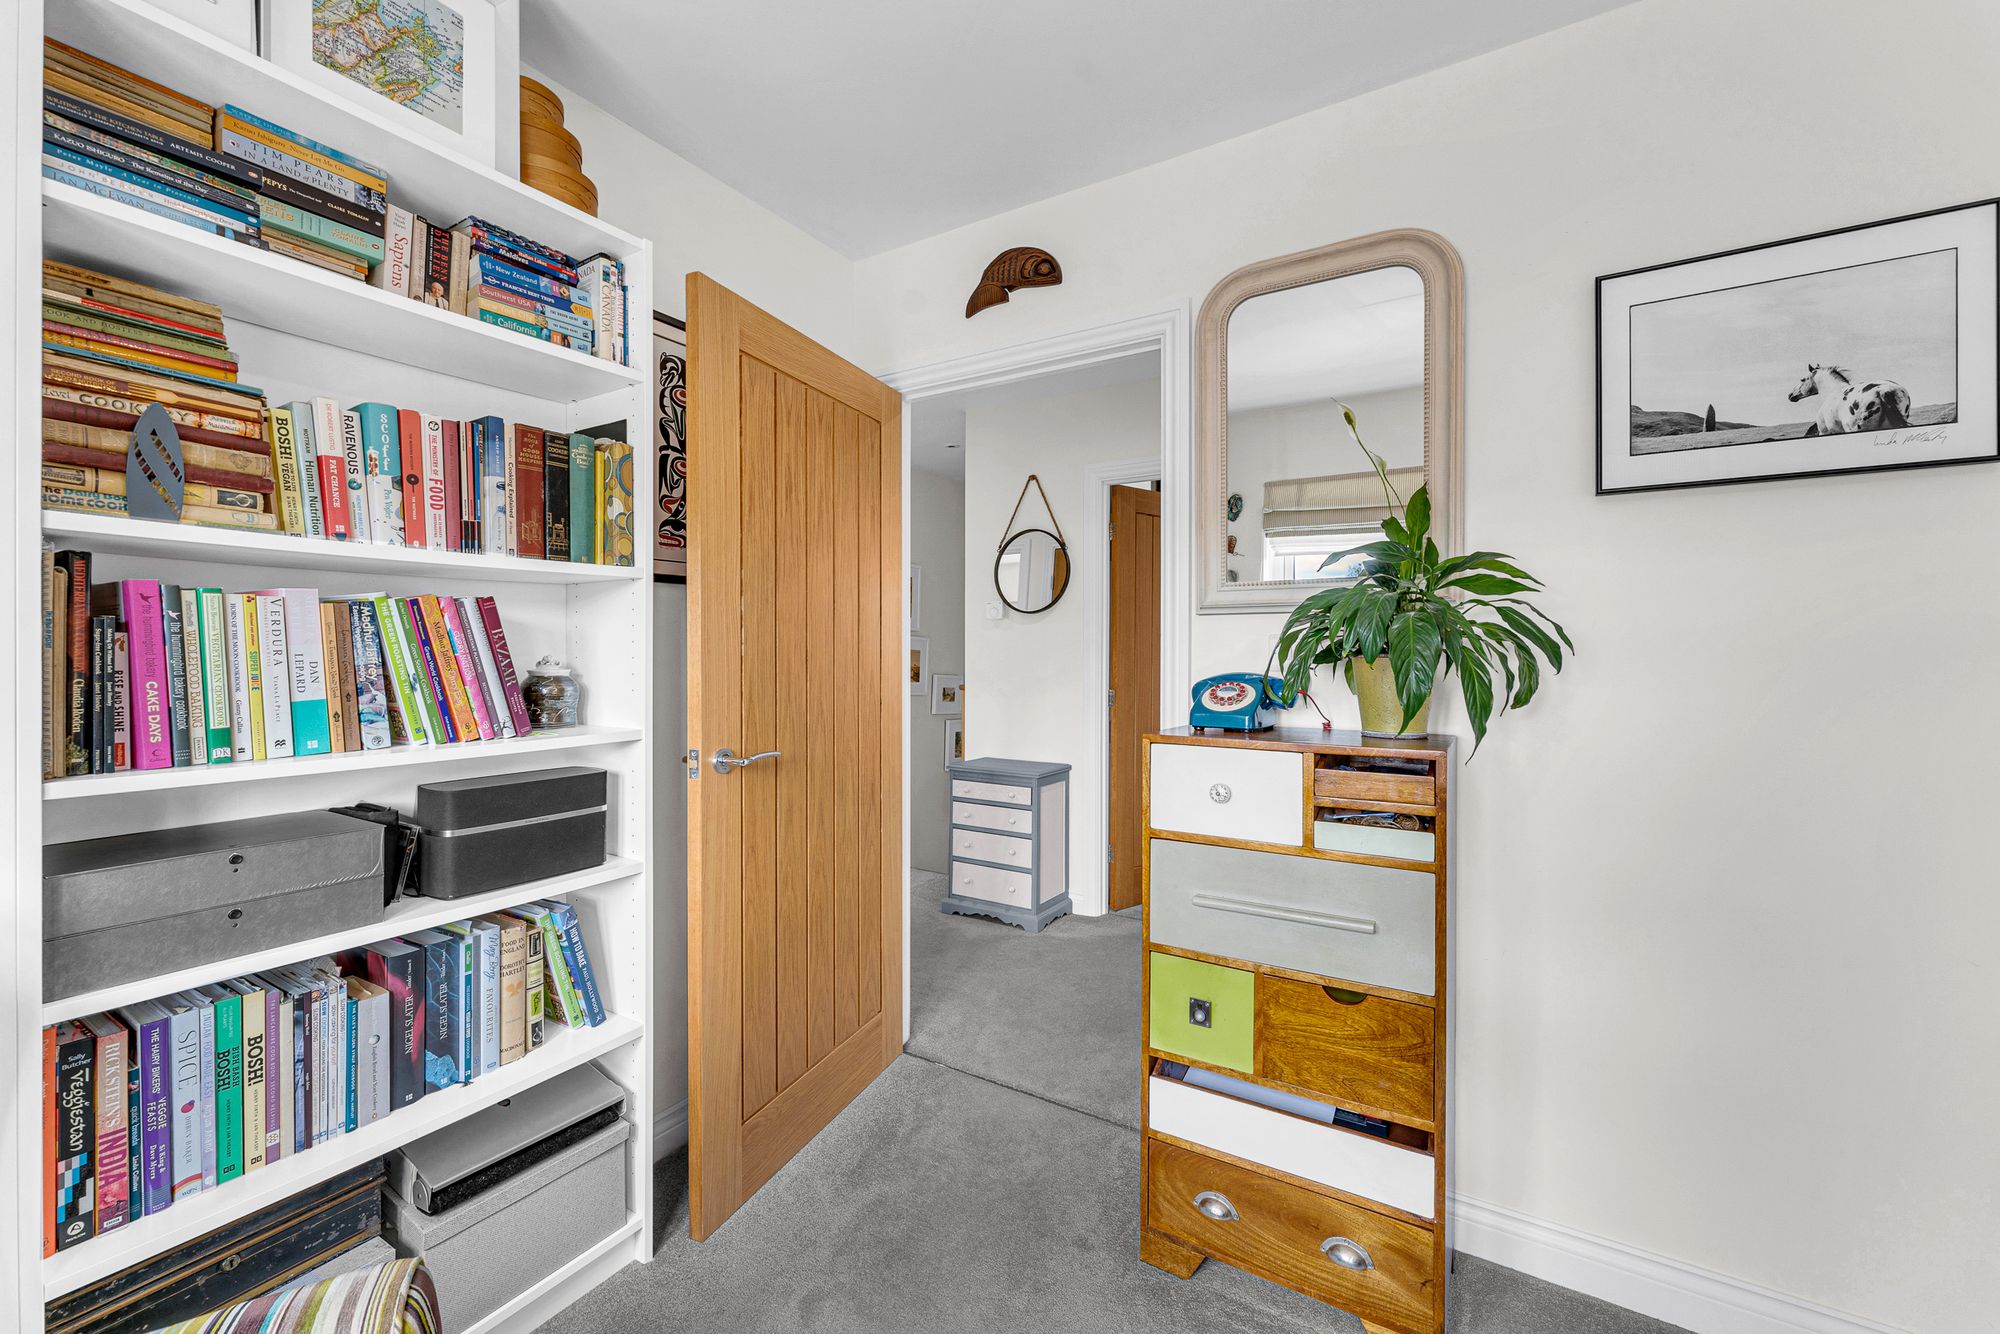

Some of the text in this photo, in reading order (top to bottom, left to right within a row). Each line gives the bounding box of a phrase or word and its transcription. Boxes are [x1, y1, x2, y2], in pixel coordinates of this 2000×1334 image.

[46, 95, 80, 112] WRITING
[94, 112, 107, 120] THE
[110, 117, 142, 134] KITCHEN
[144, 131, 164, 142] TABLE
[54, 133, 125, 163] KAZUO ISHIGURO
[170, 143, 236, 170] ARTEMIS COOPER
[251, 141, 344, 186] TIM PEARS
[53, 171, 78, 186] IAN
[57, 149, 199, 203] Peter Mayle Provence
[244, 150, 256, 161] IN
[273, 161, 301, 180] LAND
[312, 177, 349, 197] PLENTY
[262, 176, 288, 191] PEPYS
[389, 233, 409, 288] Sapiens
[433, 229, 441, 278] DIARIES
[440, 232, 449, 281] THE BENN
[496, 265, 538, 285] New Zealand
[499, 248, 529, 265] Maldives
[482, 287, 531, 307] Southwest USA
[602, 285, 610, 333] CANADA
[497, 317, 537, 336] California
[276, 416, 292, 460] BOSH!
[344, 414, 359, 475] RAVENOUS
[380, 414, 390, 471] scoff
[281, 463, 292, 492] VEGAN
[305, 460, 314, 493] Human
[329, 459, 340, 508] FAT CHANCE
[429, 478, 444, 510] FOOD
[309, 496, 321, 536] Nutrition
[384, 489, 393, 519] Pen Vogler
[73, 559, 86, 672] MEDITERRANEAN COOKERY
[270, 598, 283, 666] VERDURA
[352, 605, 360, 627] Eastern
[142, 605, 158, 678] the hummingbird bakery
[185, 630, 201, 689] WHOLEFOOD
[361, 606, 378, 682] Madhur Jaffrey
[381, 602, 410, 694] THE GREEN ROASTING TIN
[434, 621, 453, 672] Madhur Jaffrey
[453, 630, 473, 681] CURRY NATION
[492, 628, 517, 688] BAZAAR
[170, 622, 188, 730] the hummingbird bakery cookbook
[211, 631, 225, 726] VEGETARIAN COOKBOOK
[249, 650, 260, 691] SUPER JUICE
[295, 653, 306, 694] LEPARD
[309, 661, 320, 684] DAN
[414, 659, 424, 681] Seasons
[420, 678, 430, 704] Cookbook
[433, 678, 443, 702] Cookbook
[72, 679, 85, 732] Claudia Roden
[114, 691, 122, 704] AND
[145, 681, 162, 743] CAKE DAYS
[190, 691, 203, 729] BAKING
[214, 748, 230, 757] DK
[483, 933, 499, 958] Mary
[501, 939, 518, 948] FOOD
[554, 952, 567, 980] ROASTING
[570, 927, 599, 1013] HOW TO BAKE PAUL HOLLYWOOD
[405, 994, 414, 1026] SLATER
[440, 1012, 448, 1040] NIGEL
[486, 987, 494, 1043] FAVOURITES
[68, 1053, 86, 1062] Sally
[151, 1027, 161, 1094] THE HAIRY BIKERS'
[178, 1030, 198, 1090] SPICE
[202, 1013, 213, 1101] INDIAN FOOD MADE EASY
[247, 1033, 264, 1087] BOSH!
[405, 1026, 414, 1054] NIGEL
[62, 1058, 92, 1071] Butcher
[105, 1043, 121, 1128] RICK STEIN'S
[217, 1049, 231, 1093] BOSH!
[232, 1046, 240, 1087] BISH BASH
[130, 1106, 138, 1121] quick
[131, 1121, 140, 1146] breads
[147, 1101, 156, 1132] FEASTS
[158, 1096, 167, 1129] VEGGIE
[98, 1127, 127, 1190] INDIA
